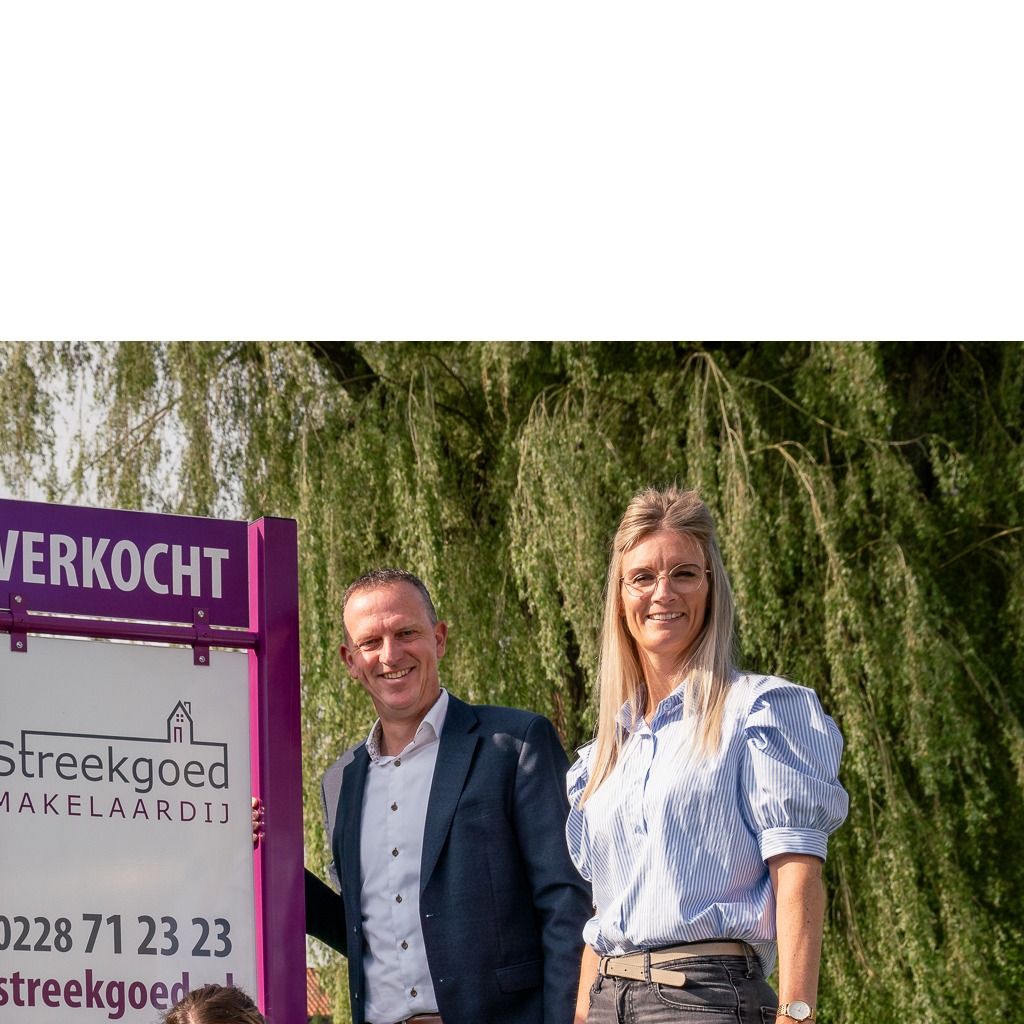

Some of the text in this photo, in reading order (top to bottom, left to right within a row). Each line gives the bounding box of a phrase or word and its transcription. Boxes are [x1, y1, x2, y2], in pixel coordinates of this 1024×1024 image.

[82, 913, 123, 954] 71
[137, 915, 179, 956] 23
[191, 917, 233, 958] 23
